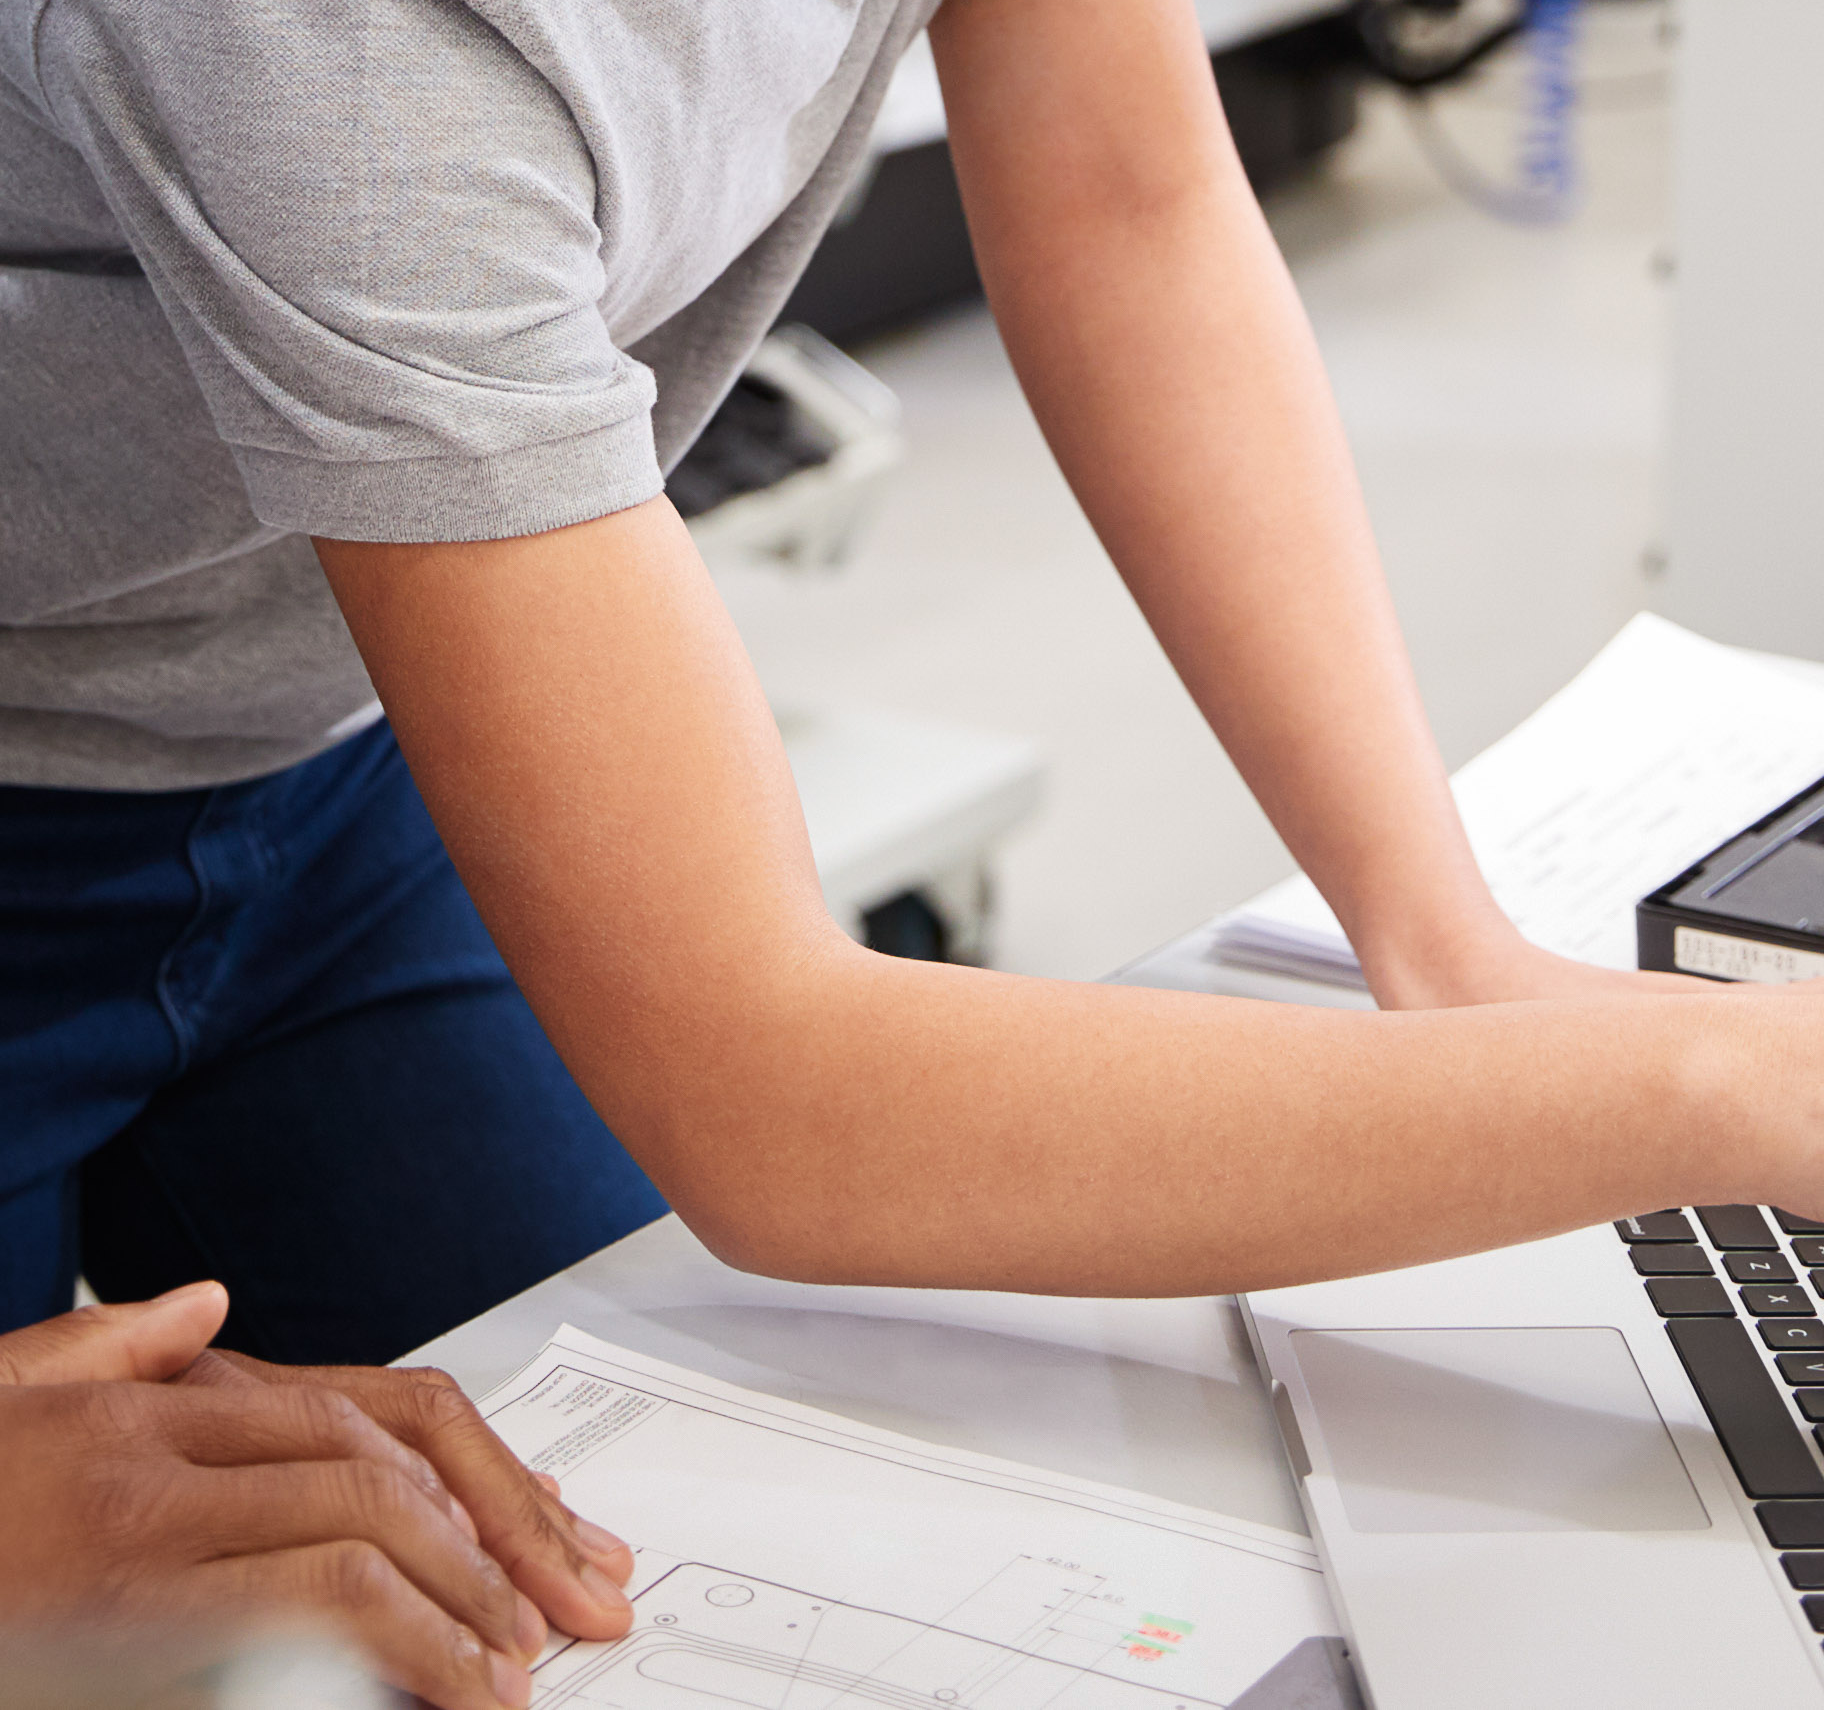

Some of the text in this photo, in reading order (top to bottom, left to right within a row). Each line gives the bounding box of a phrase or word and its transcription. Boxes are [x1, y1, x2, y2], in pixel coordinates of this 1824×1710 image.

[1750, 1262, 1771, 1270] Z
[1768, 1295, 1789, 1303] X
[1787, 1329, 1807, 1337] C
